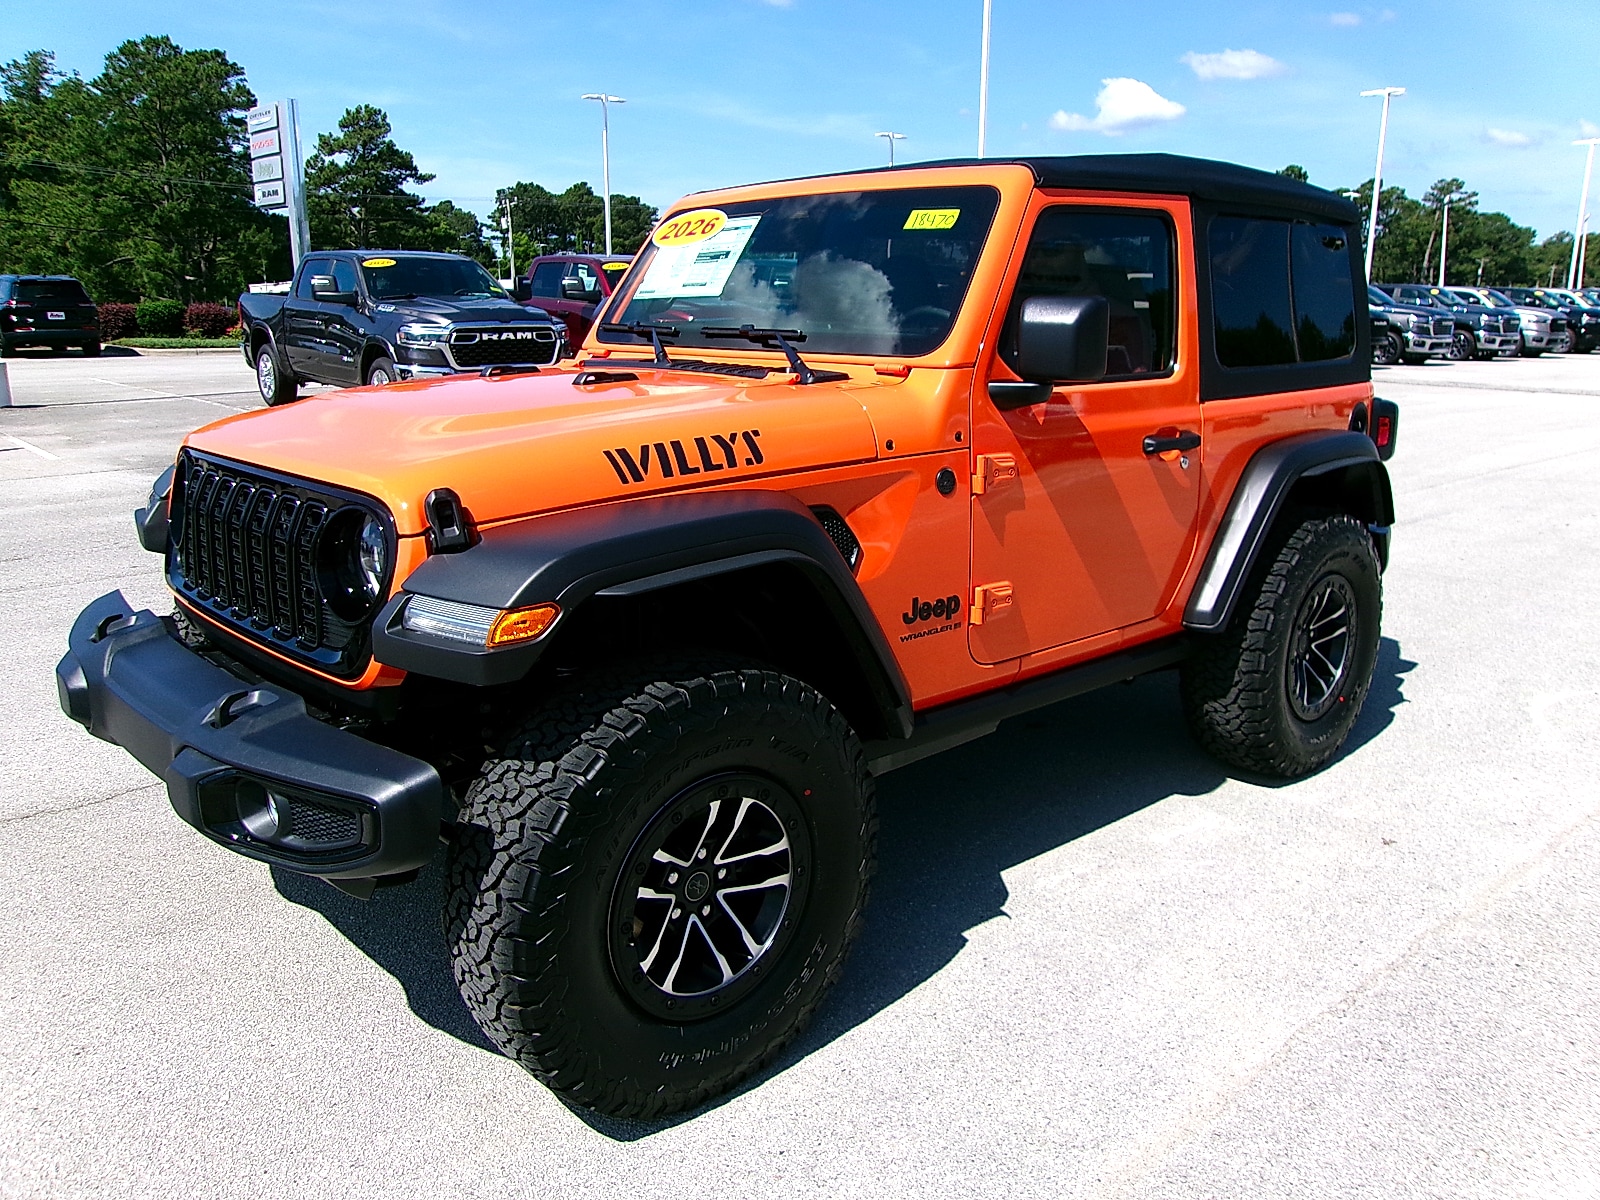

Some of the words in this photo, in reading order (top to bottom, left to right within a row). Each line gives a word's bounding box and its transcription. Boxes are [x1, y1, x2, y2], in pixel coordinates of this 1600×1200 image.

[262, 189, 279, 198] RAM
[659, 216, 720, 241] 2026
[912, 212, 955, 228] 18470
[482, 331, 534, 341] RAM
[602, 429, 764, 485] WILLYS
[902, 594, 961, 625] Jeep
[899, 624, 953, 643] WRANGLER
